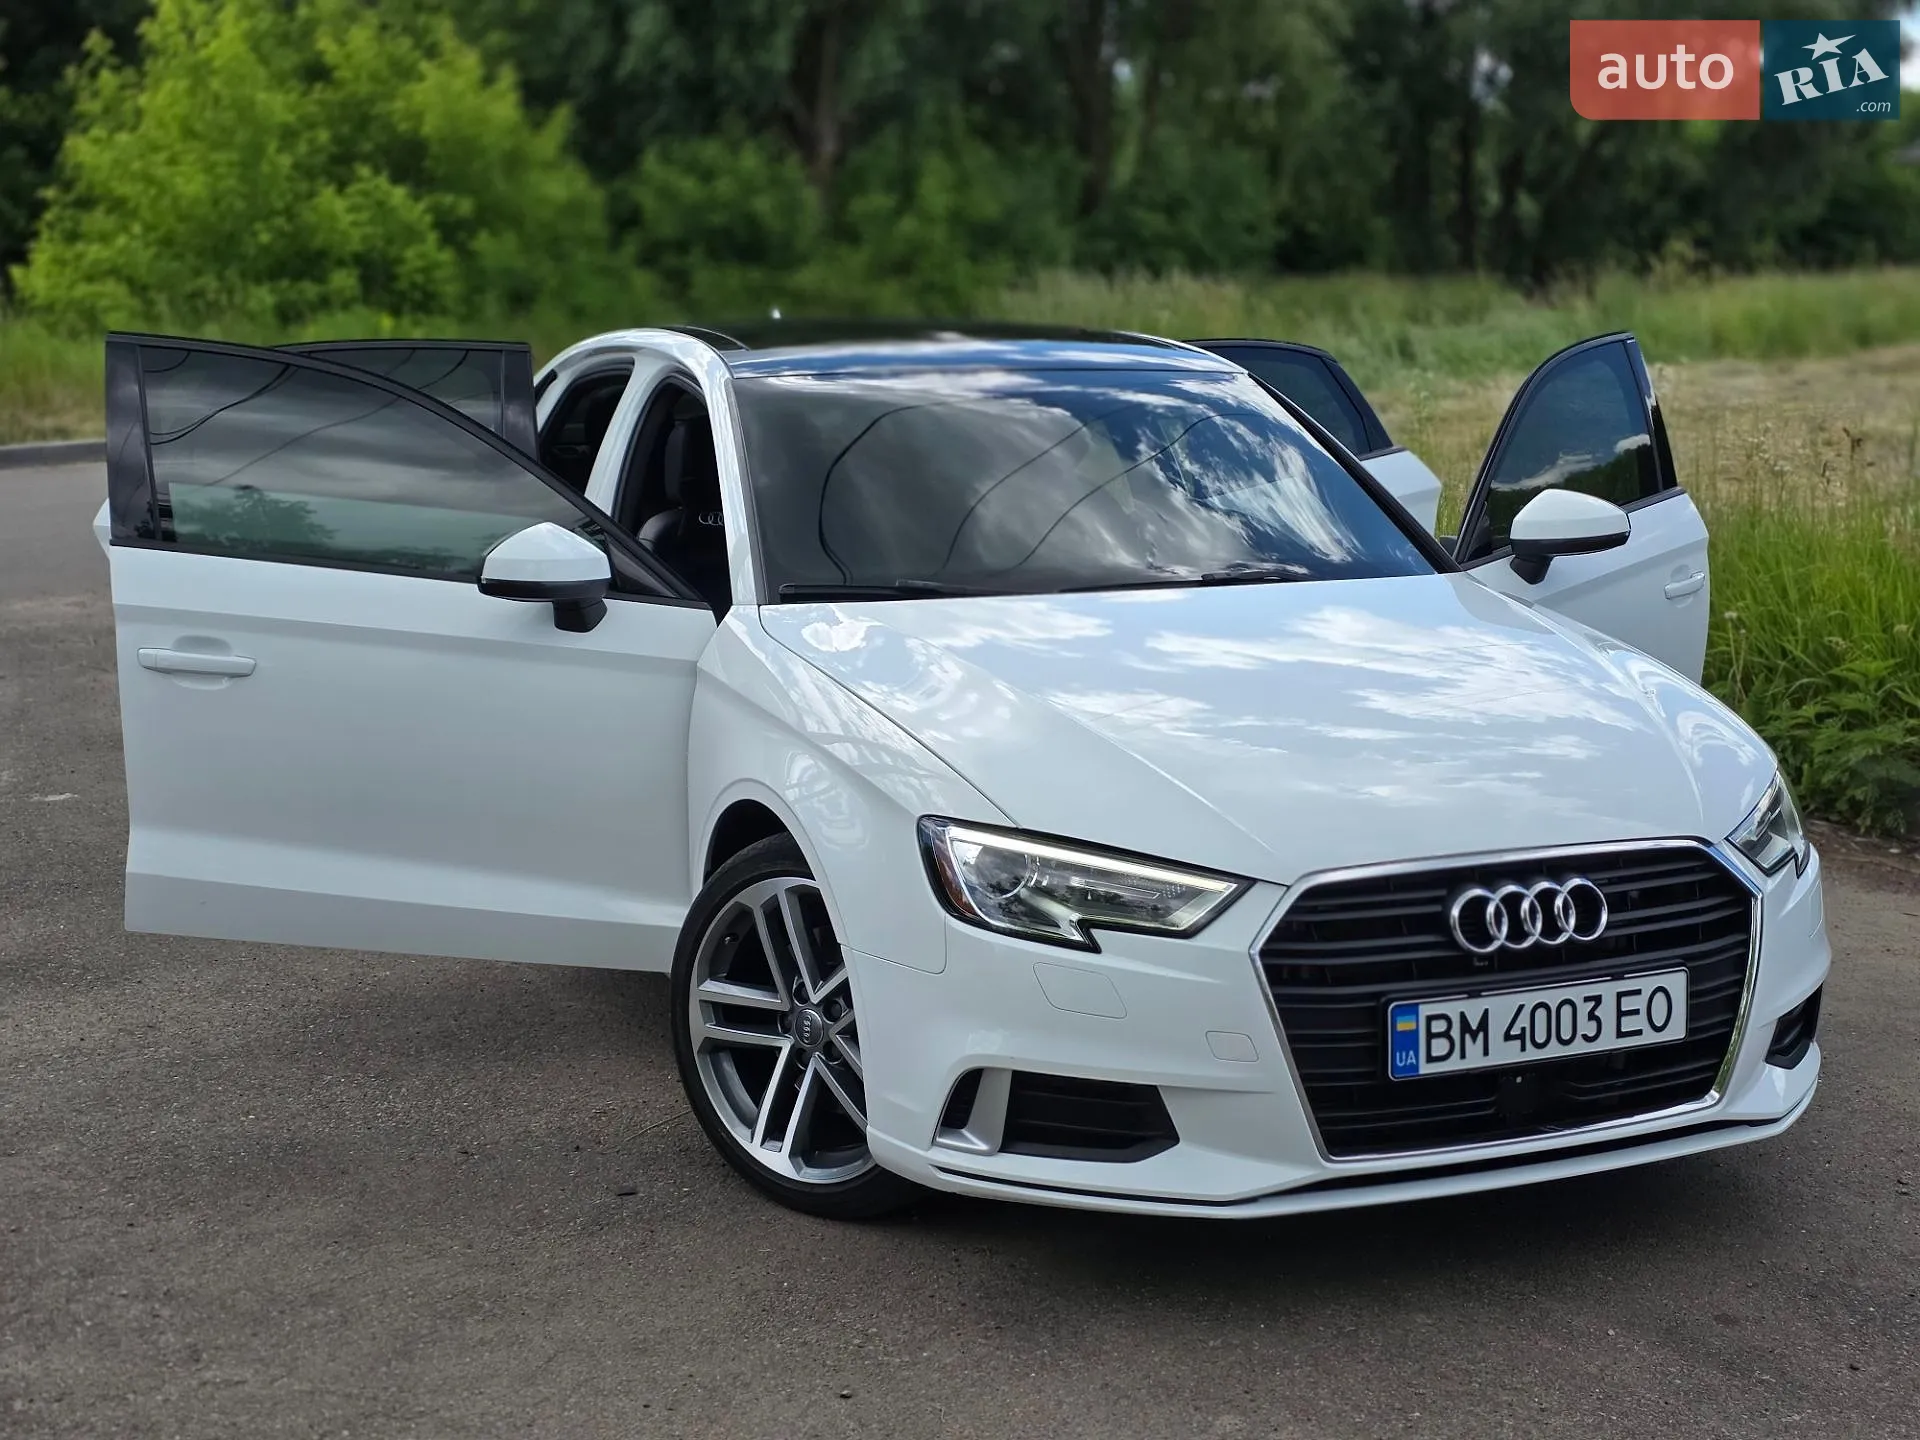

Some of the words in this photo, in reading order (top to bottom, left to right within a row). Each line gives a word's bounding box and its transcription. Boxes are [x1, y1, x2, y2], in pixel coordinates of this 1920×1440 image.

[1425, 1007, 1490, 1064] BM
[1503, 994, 1603, 1052] 4003
[1616, 985, 1673, 1039] EO
[1395, 1050, 1417, 1067] UA
